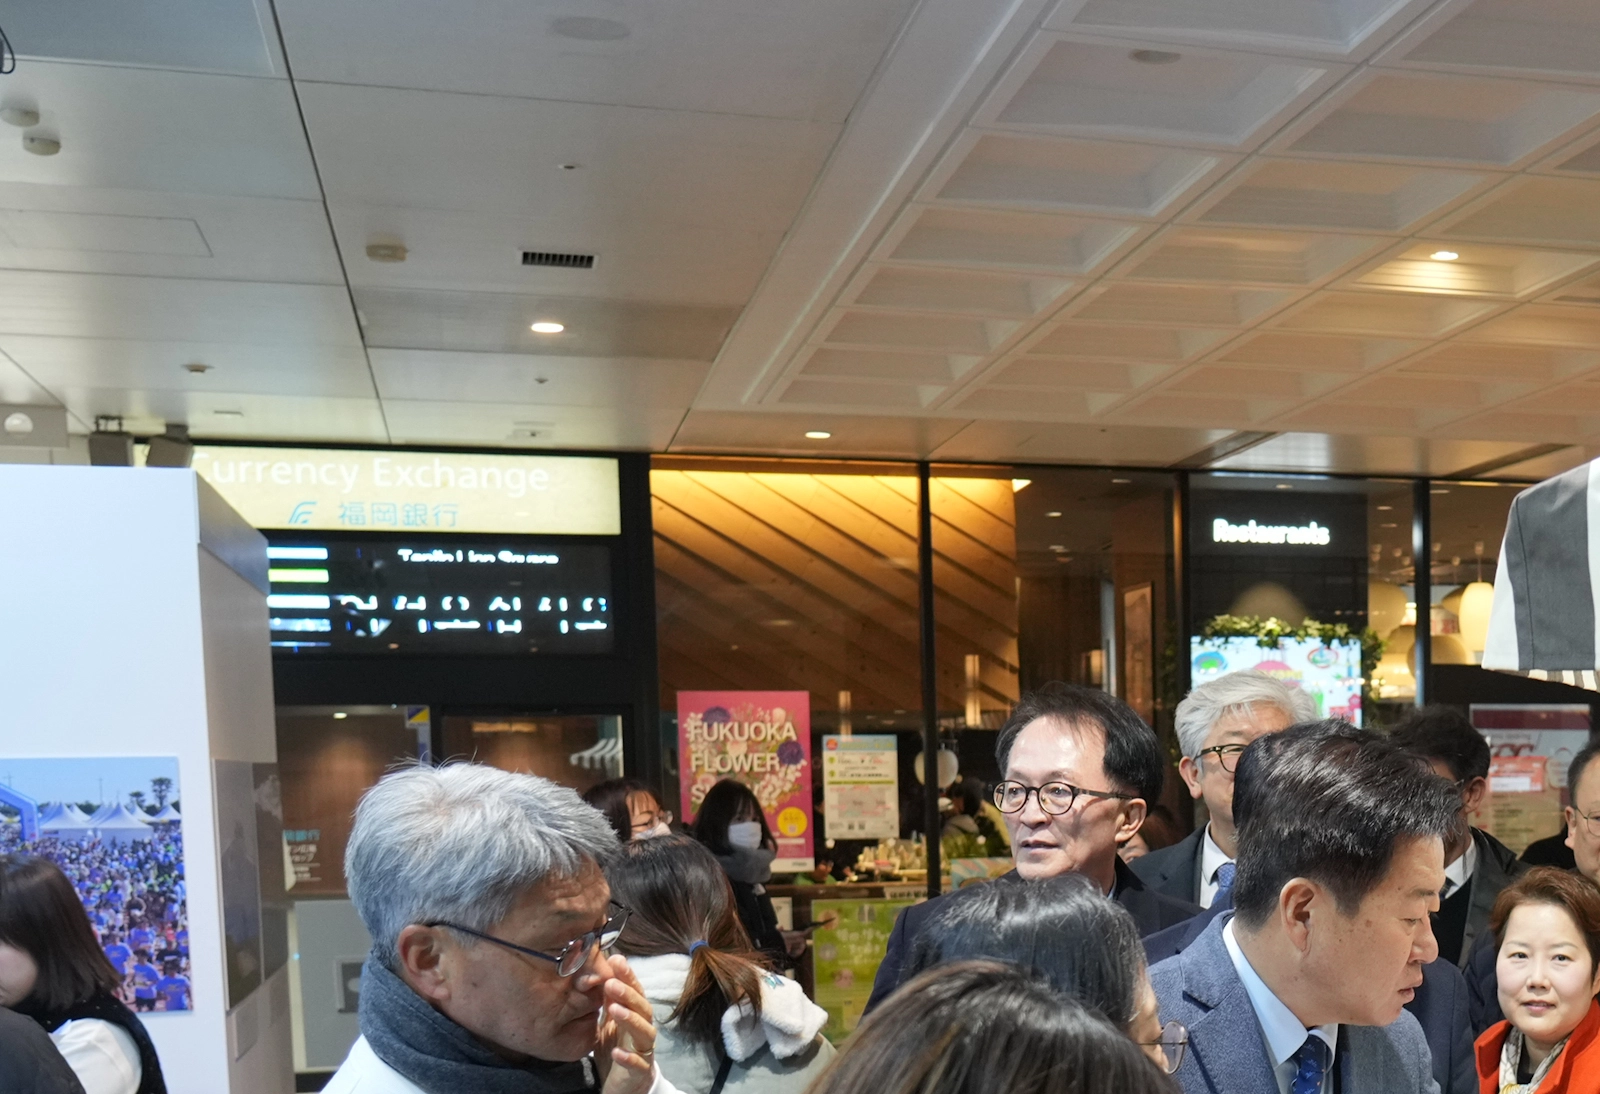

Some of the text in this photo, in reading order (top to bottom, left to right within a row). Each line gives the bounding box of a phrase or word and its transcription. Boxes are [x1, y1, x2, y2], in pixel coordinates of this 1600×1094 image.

[373, 457, 550, 498] Exchange
[338, 500, 460, 528] 福岡銀行
[1213, 518, 1330, 545] Restaurants
[690, 721, 797, 742] FUKUOKA
[691, 752, 780, 773] FLOWER
